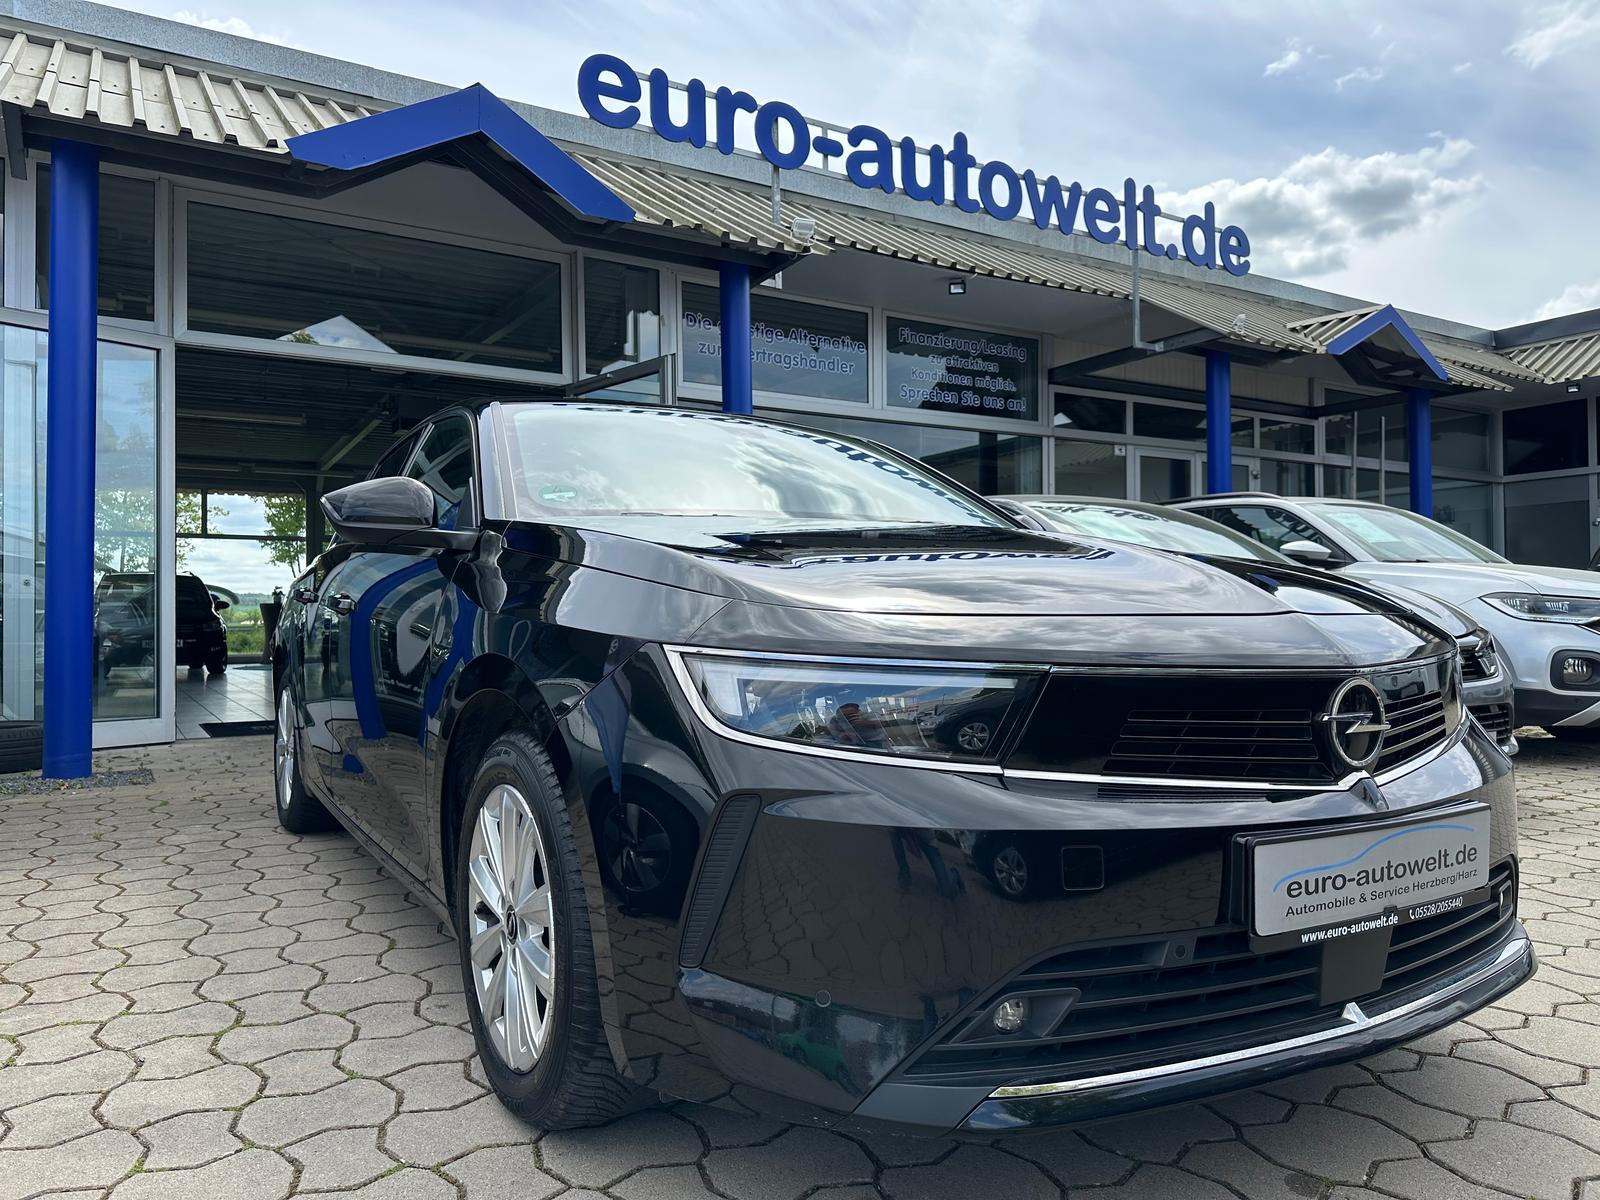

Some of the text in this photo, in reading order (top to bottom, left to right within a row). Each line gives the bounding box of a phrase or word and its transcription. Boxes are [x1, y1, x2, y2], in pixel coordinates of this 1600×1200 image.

[577, 53, 1251, 277] euro-autowelt.de
[685, 312, 712, 331] Die
[788, 328, 868, 354] Alternative
[899, 327, 1027, 364] Finanzierung/Leasing
[750, 347, 855, 374] ertragshändler
[911, 366, 1017, 392] Konditionen möglich.
[929, 354, 999, 373] zu attraktiven
[900, 384, 1027, 412] Sprechen Sie uns an!
[1286, 844, 1478, 899] euro-autowelt.de
[1285, 868, 1478, 917] Automobile & Service Herzberg/Harz
[1301, 896, 1463, 943] www.euro-autowelt.de 05528/2055440
